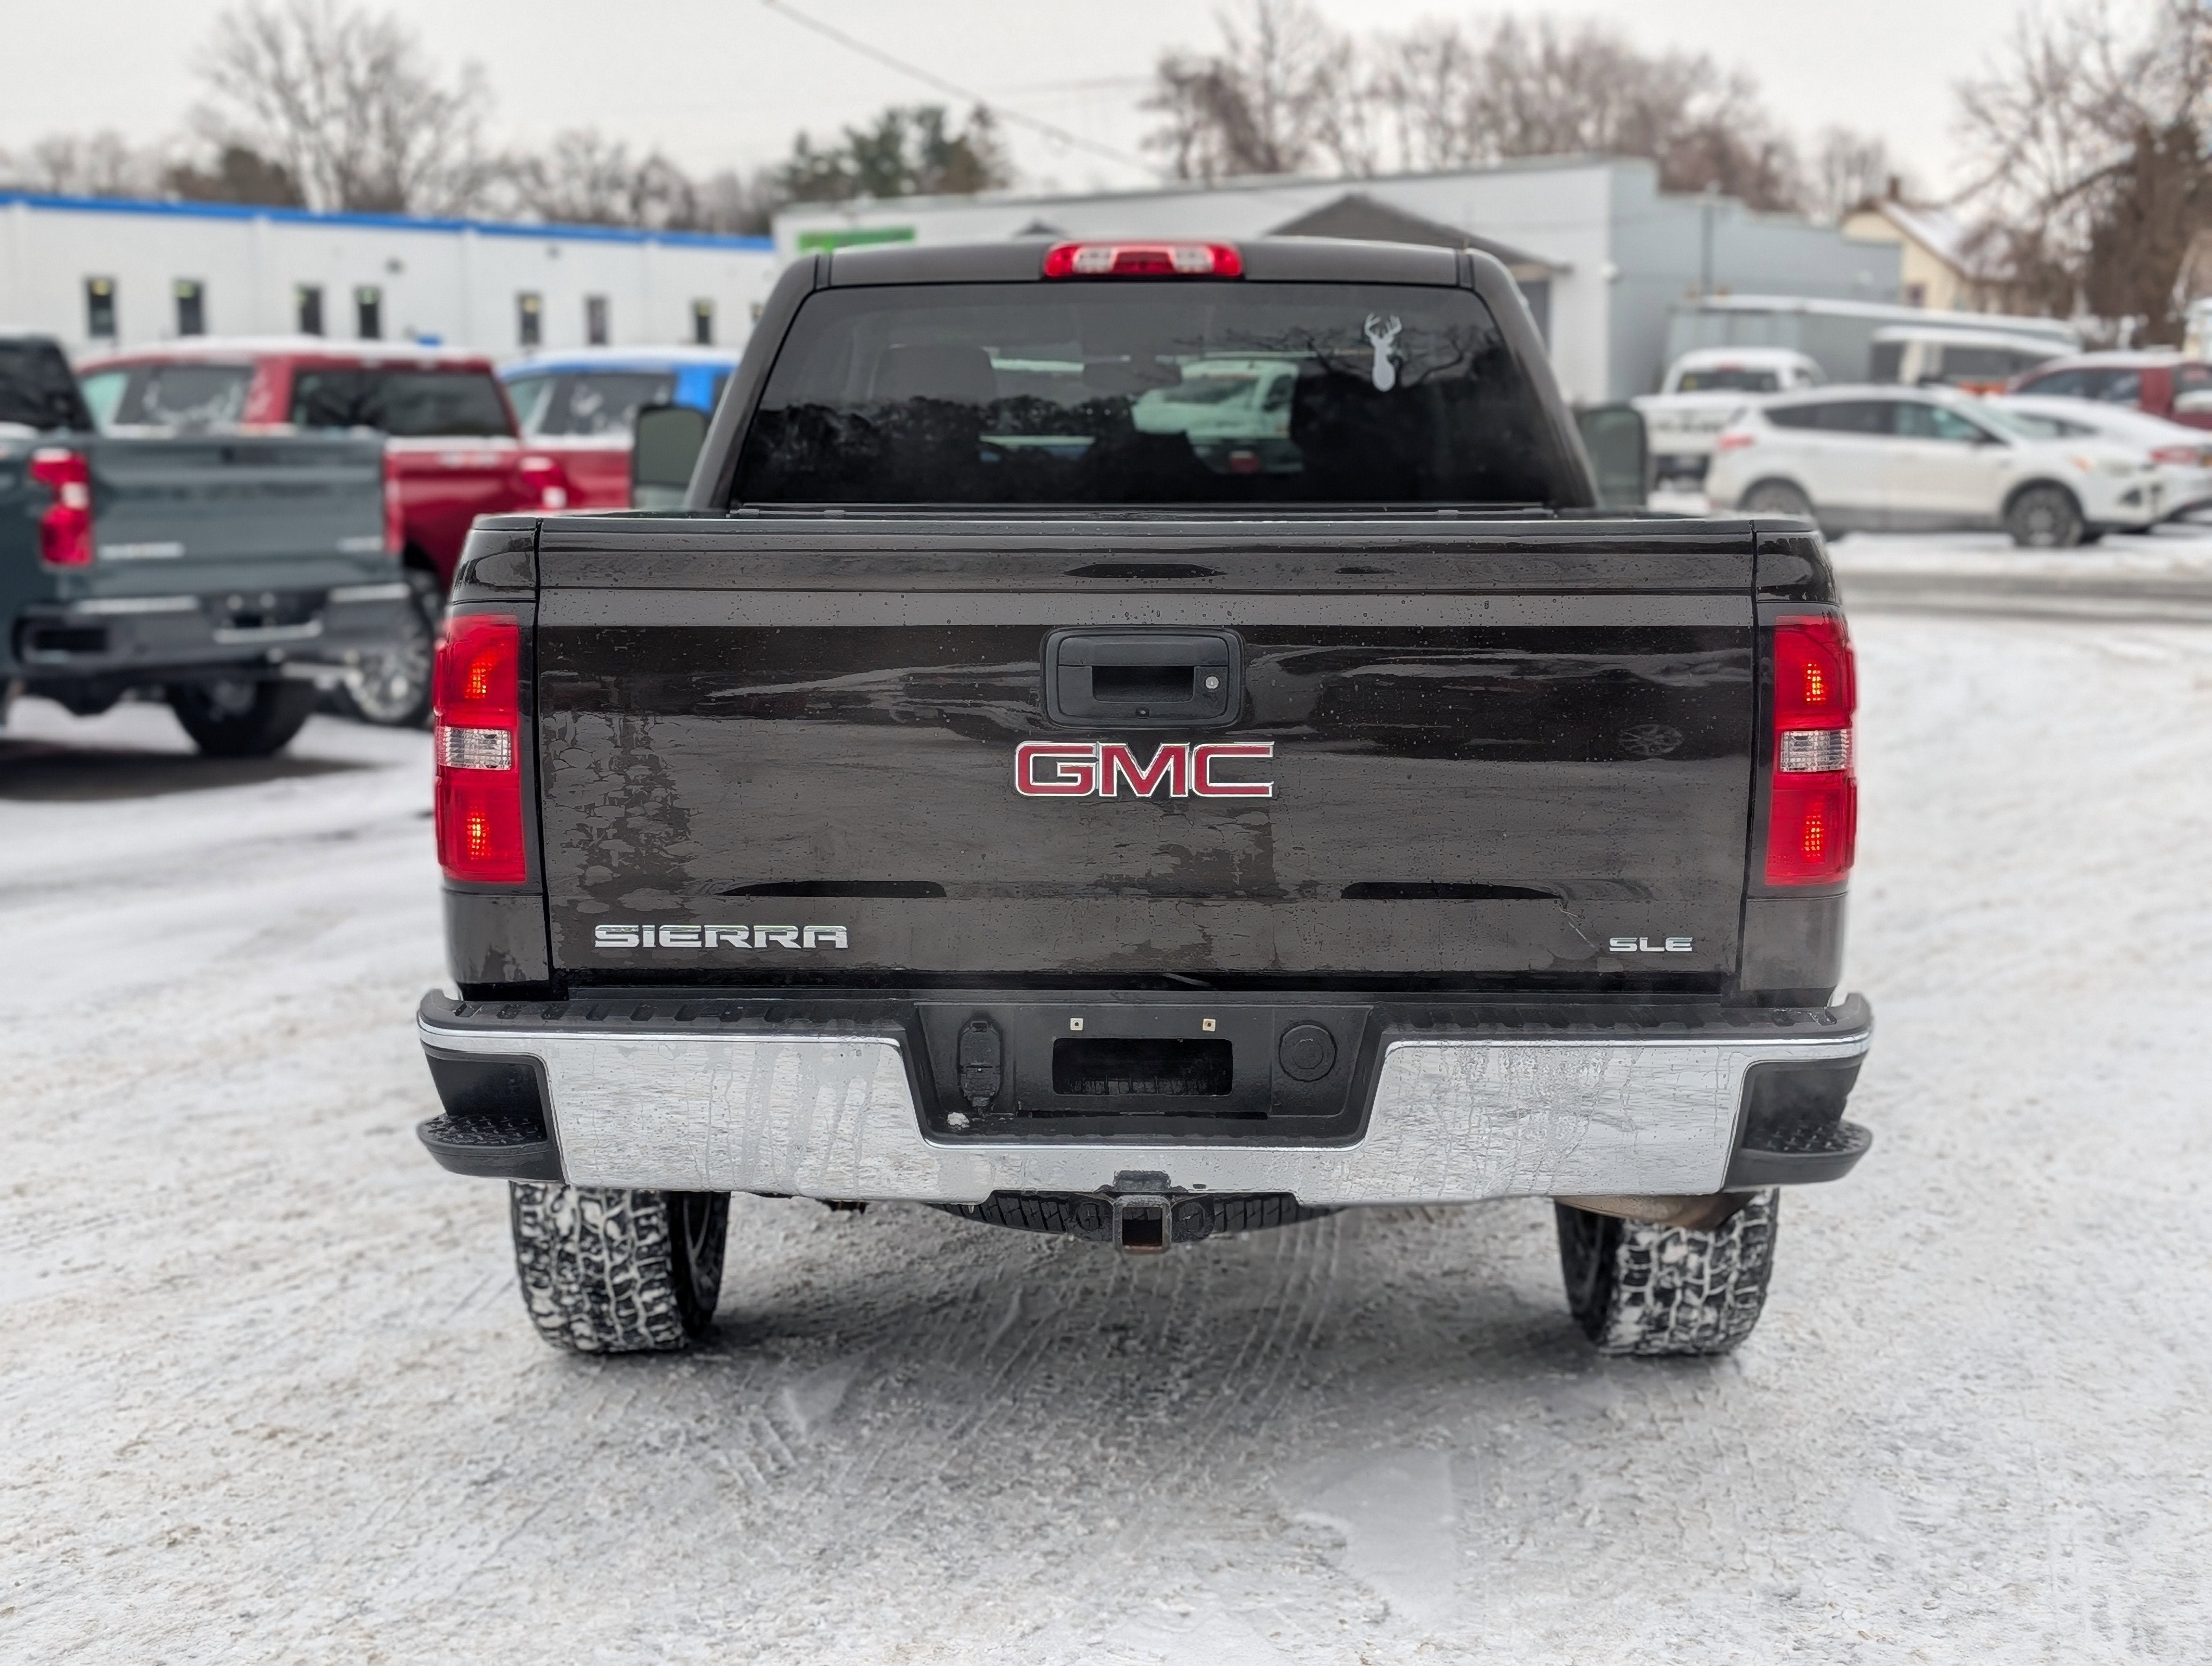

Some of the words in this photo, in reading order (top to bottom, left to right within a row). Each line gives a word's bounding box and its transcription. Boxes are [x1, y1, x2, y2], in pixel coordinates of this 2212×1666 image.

[1015, 741, 1274, 798] GMC
[595, 925, 848, 949] SIERRA
[1609, 937, 1693, 952] SLE
